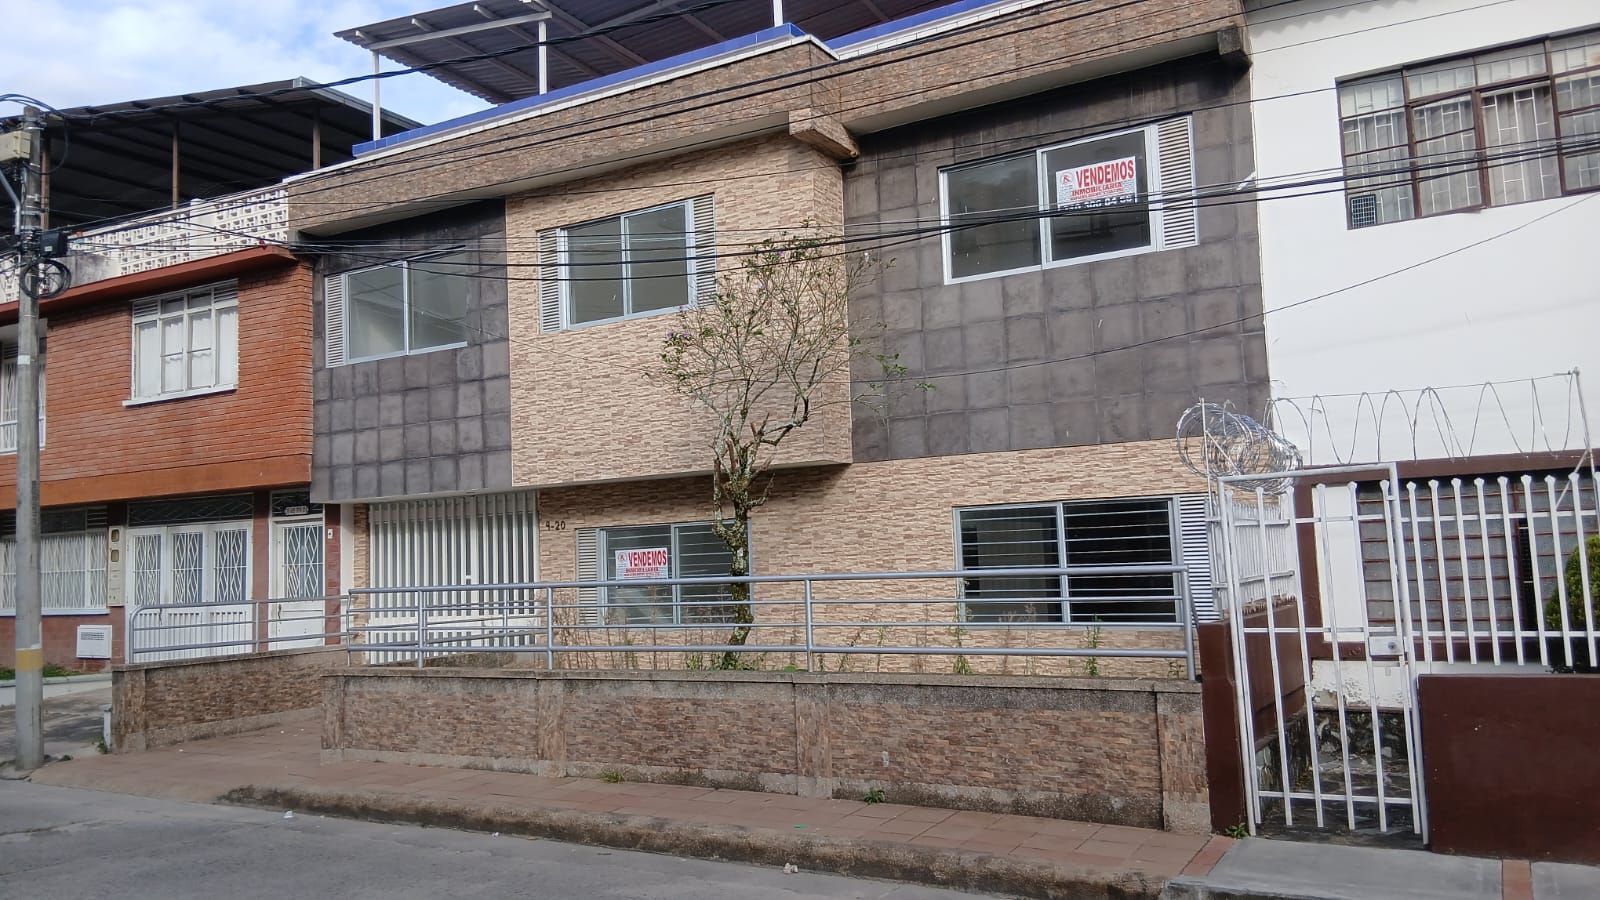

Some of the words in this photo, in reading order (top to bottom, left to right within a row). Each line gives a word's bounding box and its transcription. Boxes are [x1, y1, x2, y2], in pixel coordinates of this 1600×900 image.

[1076, 160, 1135, 188] VENDEMOS
[1072, 181, 1122, 196] INMOBILIARIA
[628, 550, 667, 567] VENDEMOS
